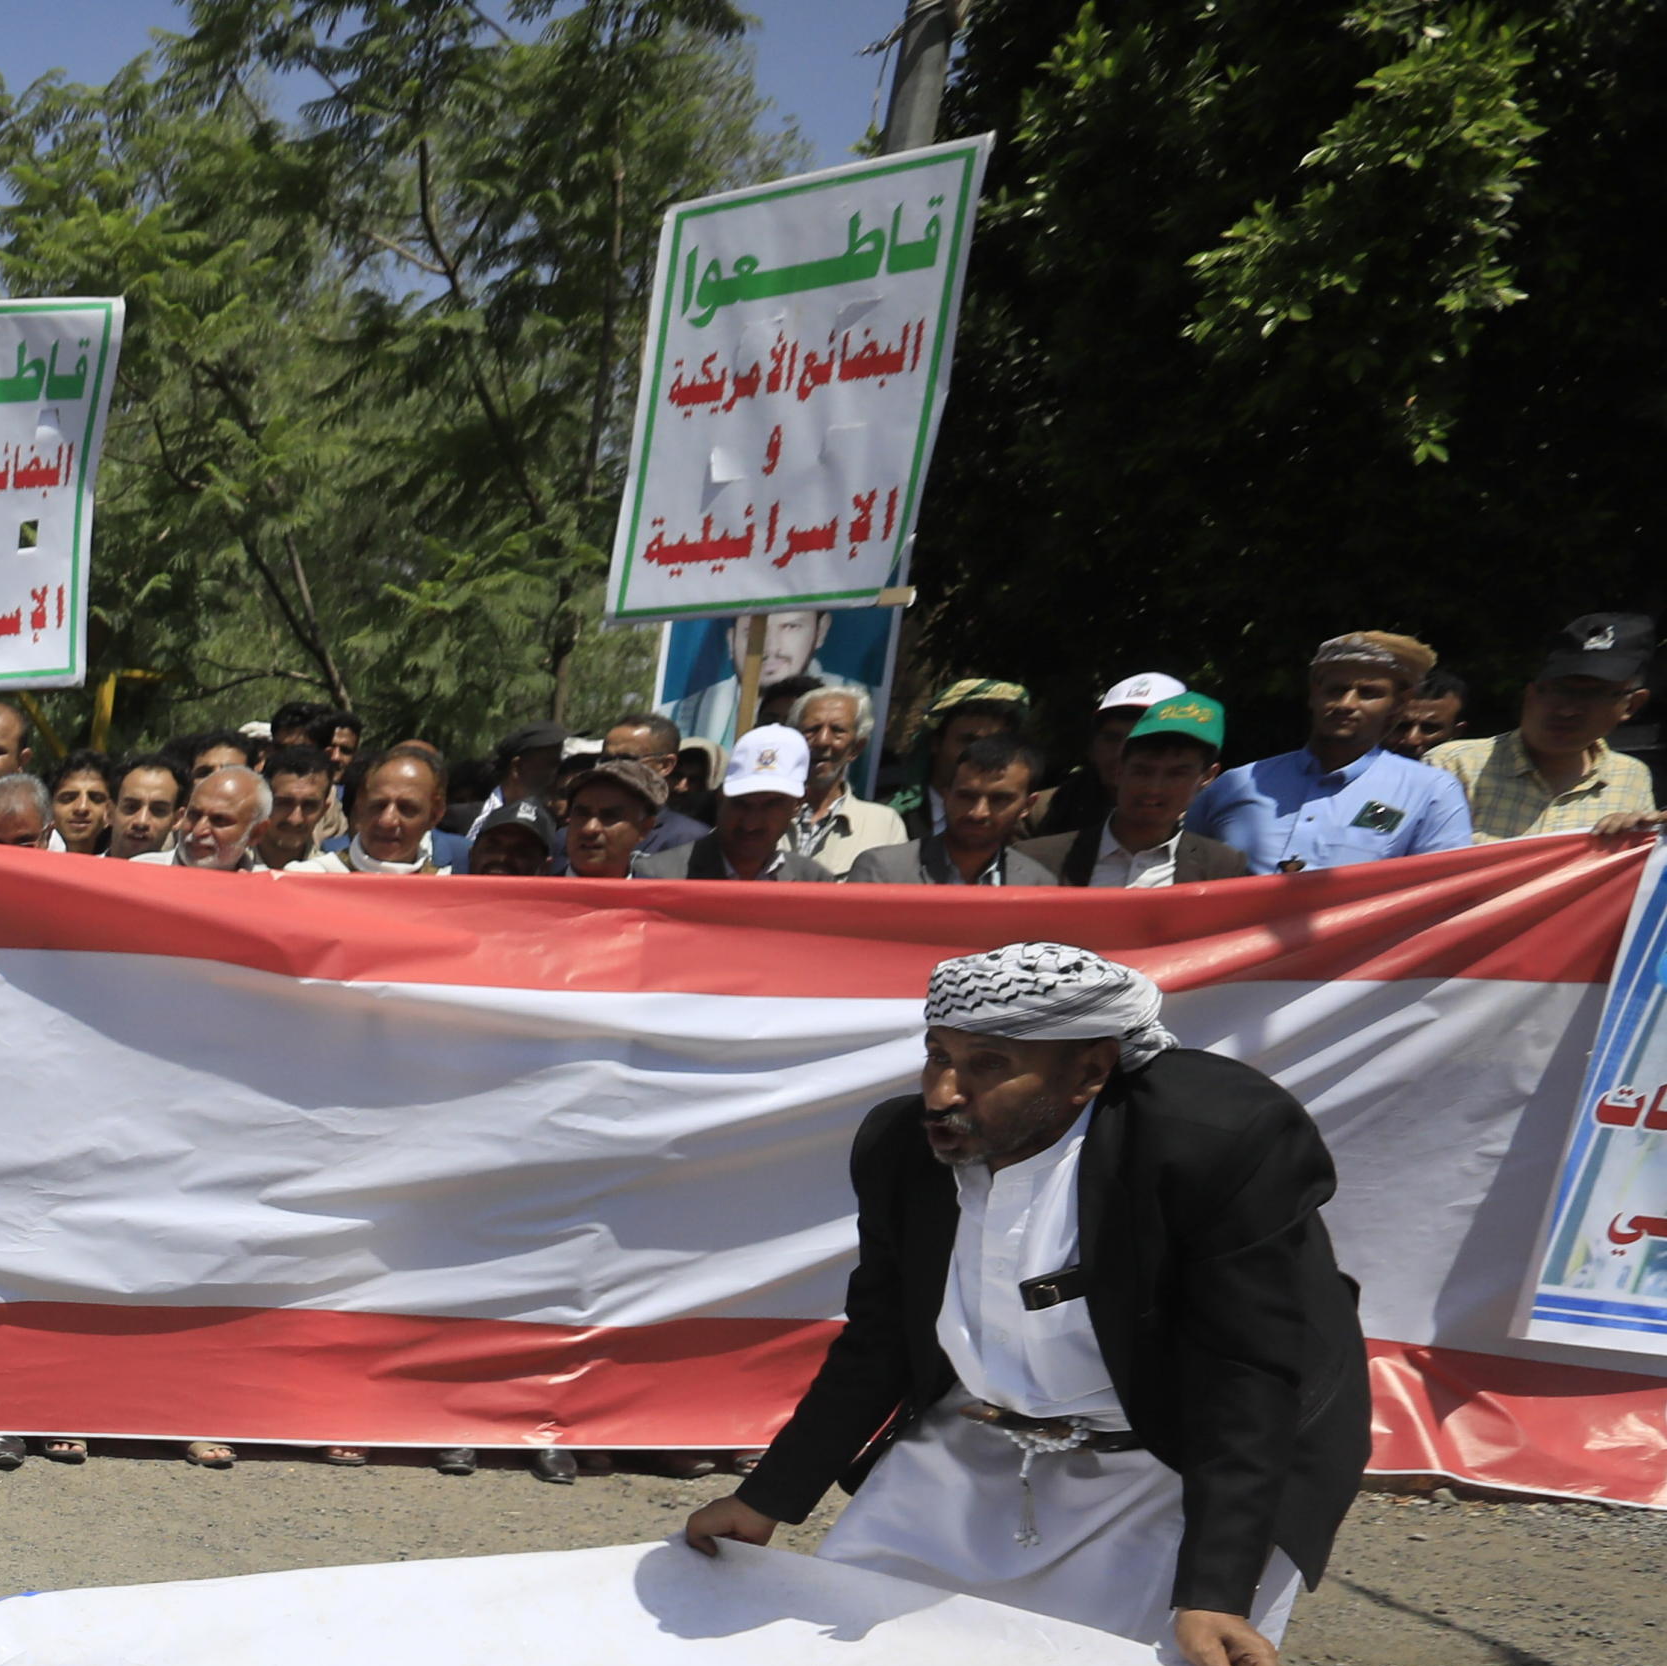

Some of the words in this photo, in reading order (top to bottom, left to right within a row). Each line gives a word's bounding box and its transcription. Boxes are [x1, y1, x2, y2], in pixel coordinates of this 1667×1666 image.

[681, 194, 944, 328] قاطعوا
[668, 328, 799, 420] الأمريكية
[797, 317, 927, 402] البضائع
[762, 423, 783, 476] و
[642, 486, 900, 577] الإسرائيلية
